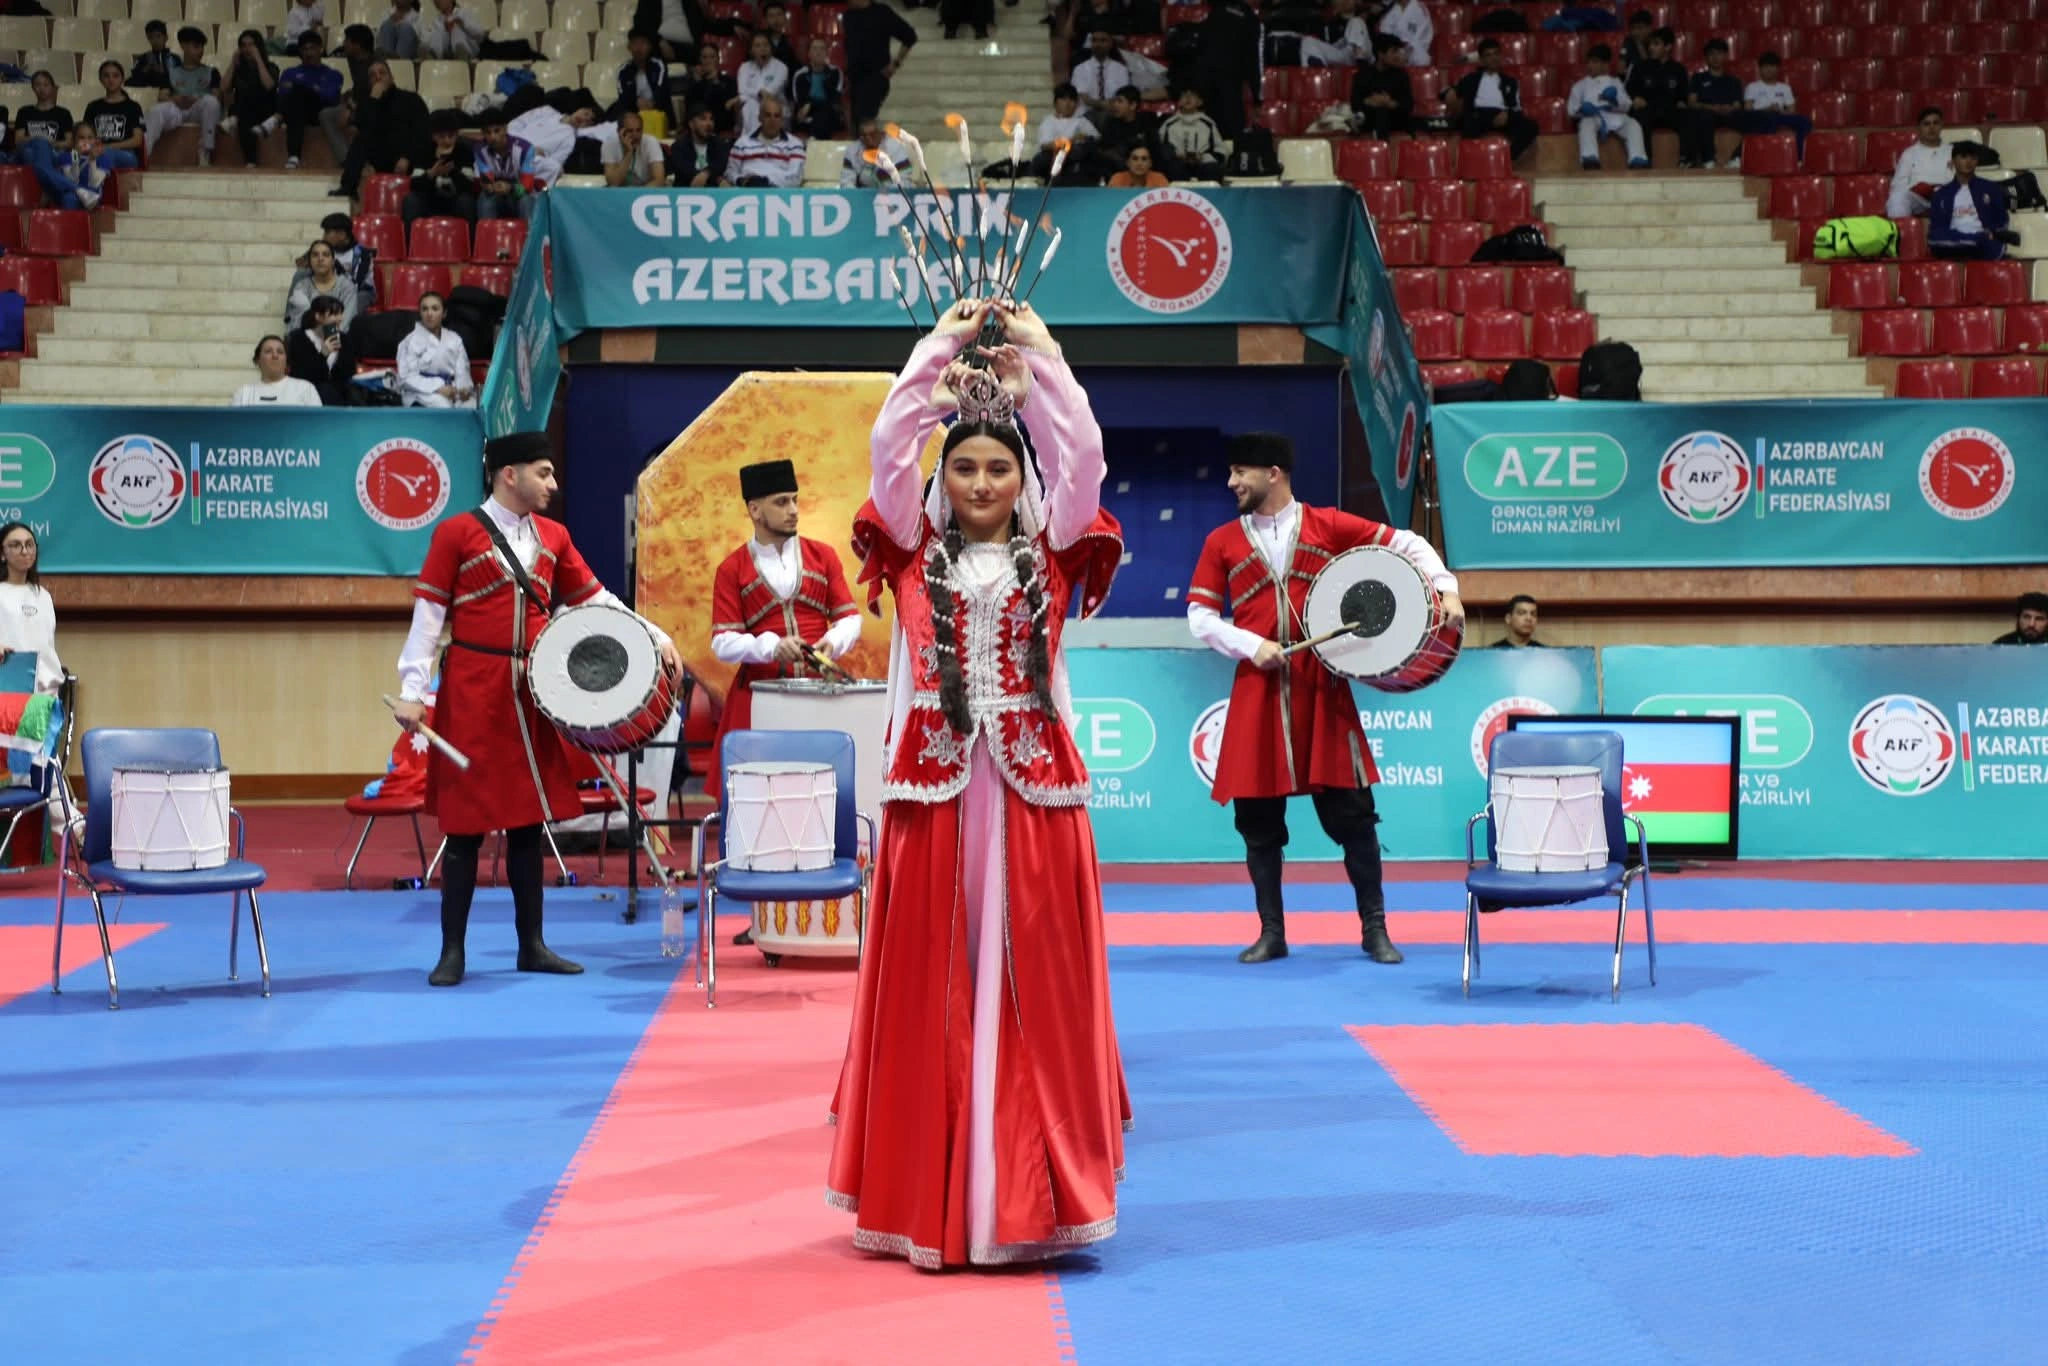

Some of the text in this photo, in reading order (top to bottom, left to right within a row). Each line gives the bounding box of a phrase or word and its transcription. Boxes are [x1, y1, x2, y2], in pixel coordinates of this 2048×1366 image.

[632, 193, 1013, 242] GRAND PRIX
[633, 257, 1009, 309] AZERBAIJAN
[205, 448, 320, 467] AZƏRBAYCAN
[1770, 441, 1884, 460] AZƏRBAYCAN
[1494, 446, 1597, 487] AZE
[121, 475, 156, 488] AKF
[205, 474, 274, 493] KARATE
[1689, 471, 1723, 484] AKF
[1769, 467, 1837, 486] KARATE
[205, 496, 328, 519] FEDERASİYASI
[1769, 488, 1891, 512] FEDERASİYASI
[1491, 504, 1595, 519] GƏNCLƏR VƏ
[1491, 516, 1620, 534] İDMAN NAZİRLİYİ
[1360, 710, 1432, 730] BAYCAN
[1884, 738, 1923, 751] AKF
[1977, 735, 2048, 756] KARATE
[1377, 761, 1443, 785] SİYASI
[1754, 774, 1780, 788] VƏ
[1096, 777, 1121, 791] VƏ
[1088, 791, 1151, 808] ZİRLİYİ
[1739, 787, 1811, 805] AZİRLİYİ
